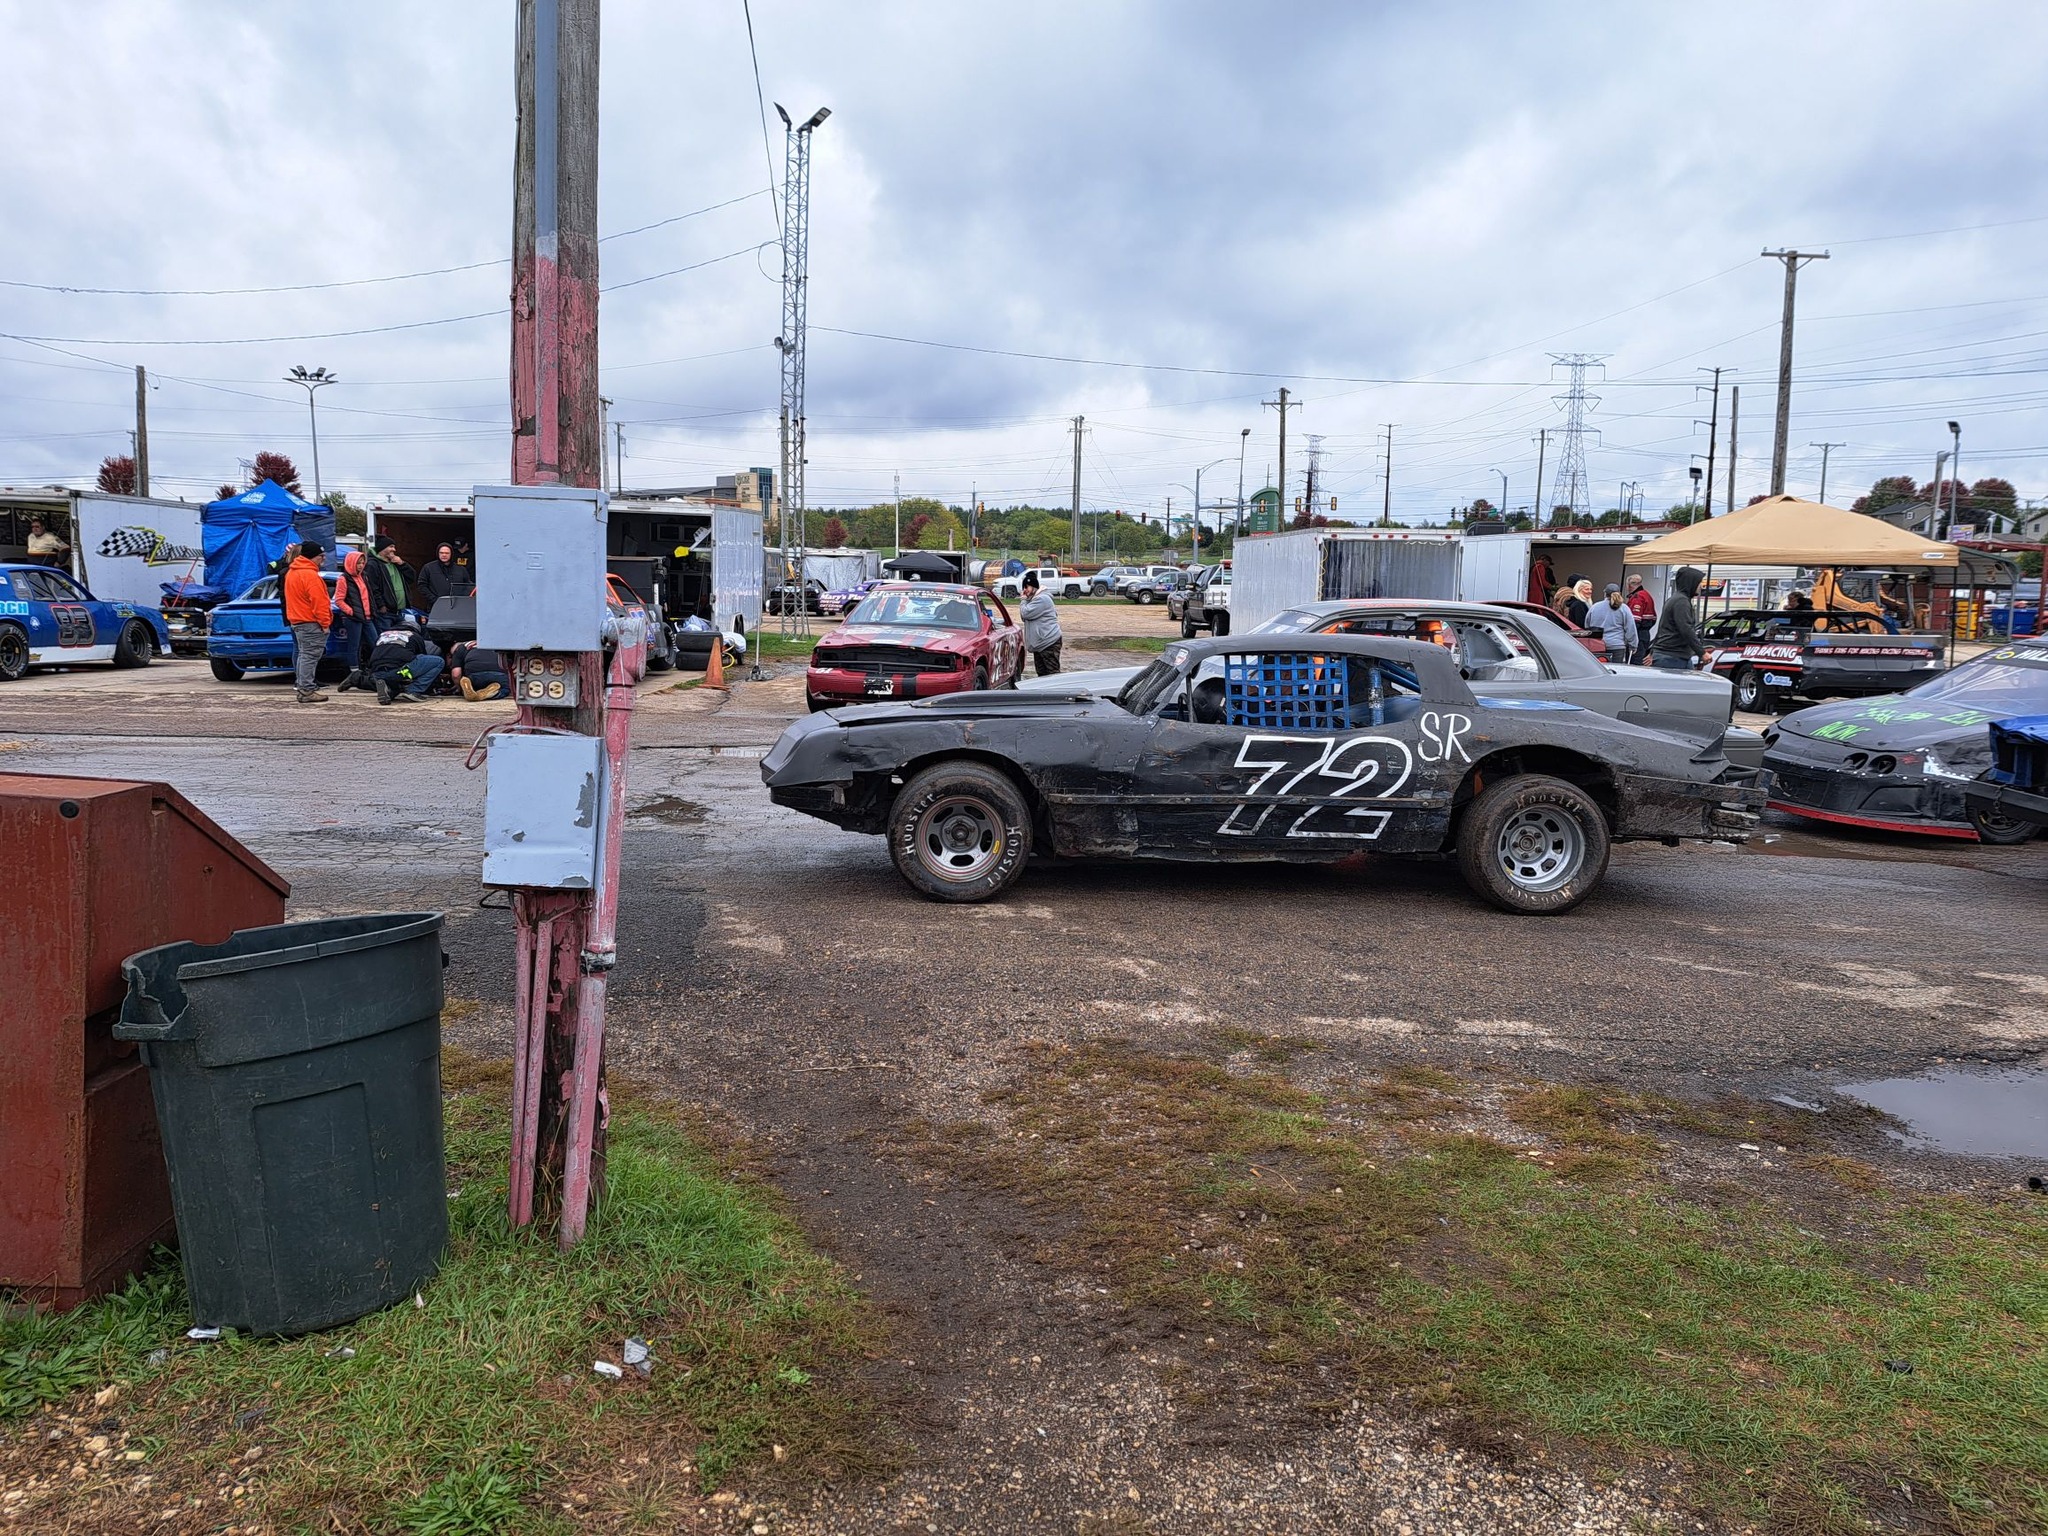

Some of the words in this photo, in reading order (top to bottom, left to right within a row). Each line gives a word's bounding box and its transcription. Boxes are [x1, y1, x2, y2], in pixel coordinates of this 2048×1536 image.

[1759, 646, 1798, 659] RACING
[1418, 711, 1472, 763] SR
[1217, 735, 1413, 839] 72
